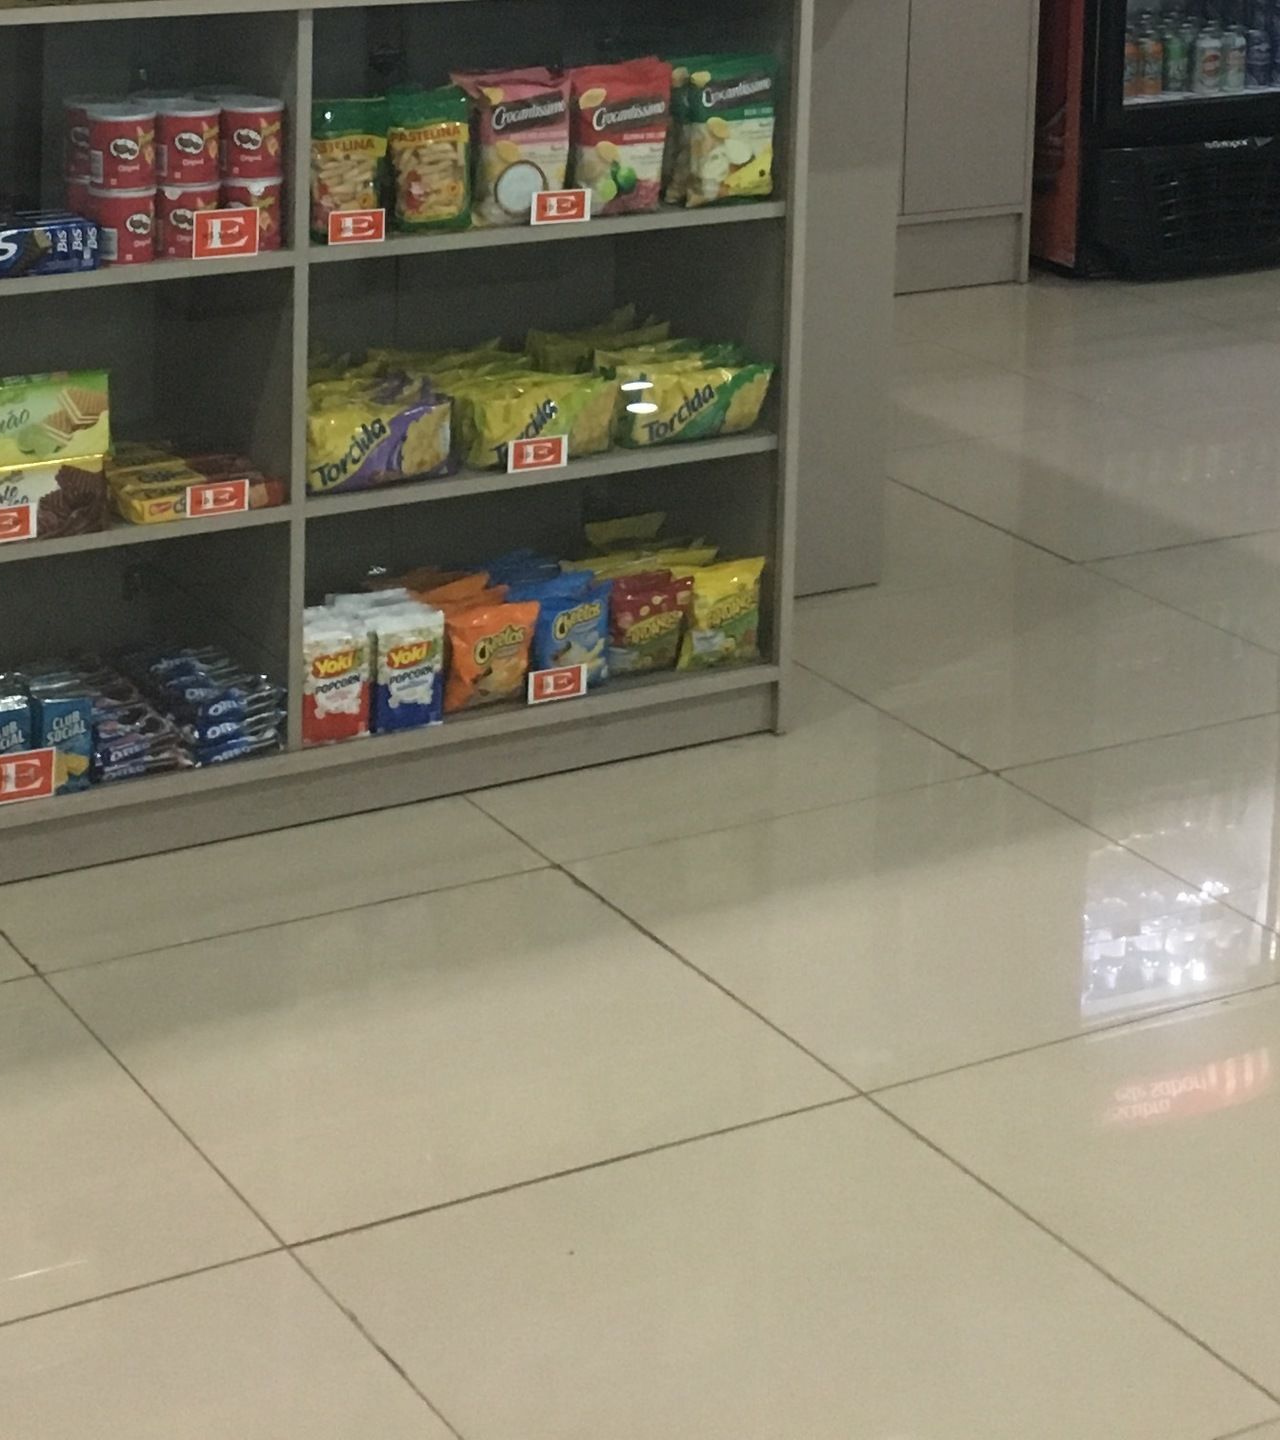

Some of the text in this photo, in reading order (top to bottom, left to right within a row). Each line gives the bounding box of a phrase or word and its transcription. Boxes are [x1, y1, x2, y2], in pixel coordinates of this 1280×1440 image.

[206, 217, 248, 249] E
[315, 673, 361, 695] POPCORN
[389, 665, 434, 685] POPCORN
[51, 711, 81, 732] CLUB
[0, 759, 42, 794] E
